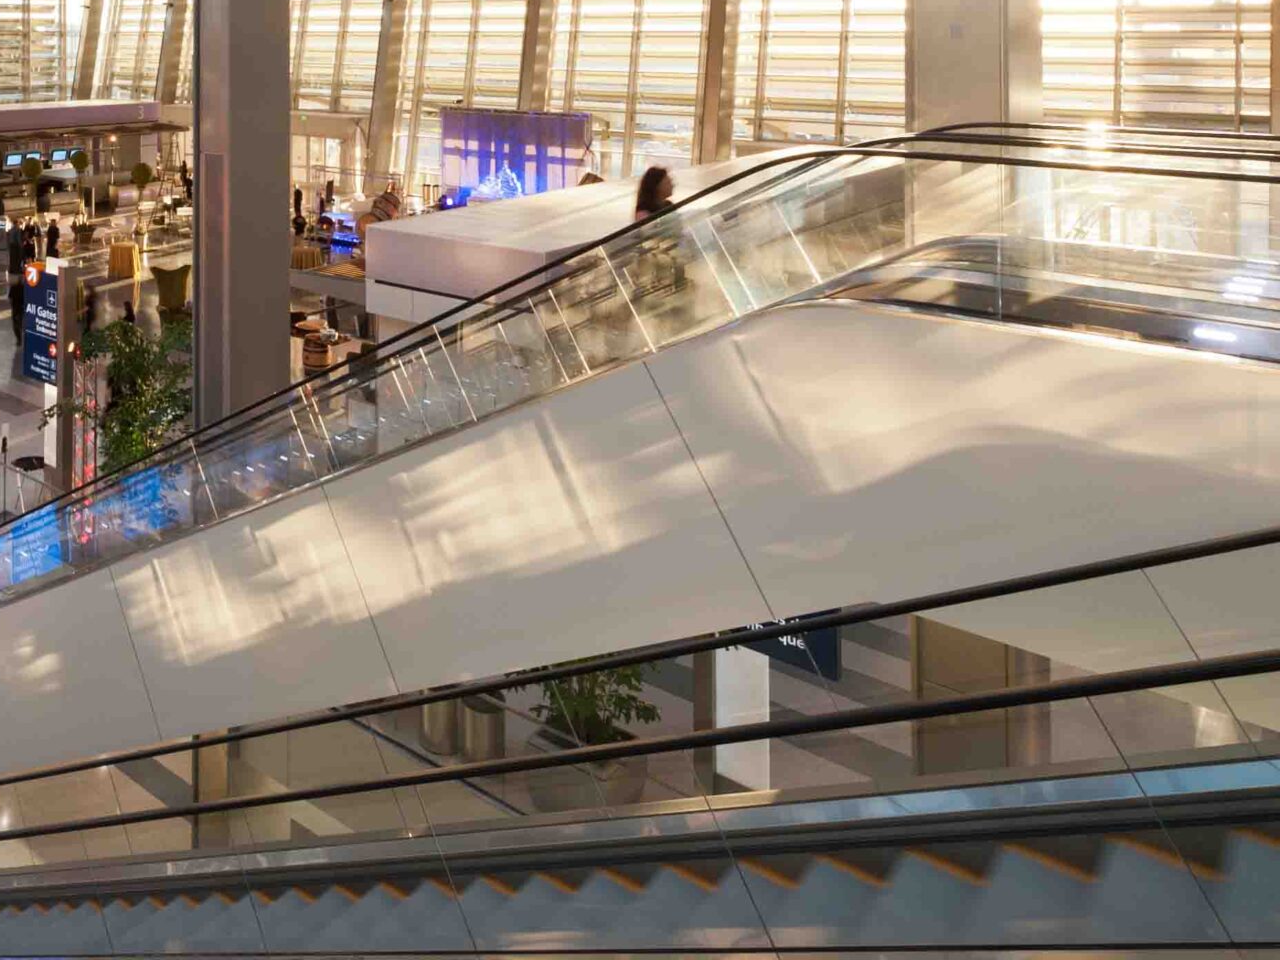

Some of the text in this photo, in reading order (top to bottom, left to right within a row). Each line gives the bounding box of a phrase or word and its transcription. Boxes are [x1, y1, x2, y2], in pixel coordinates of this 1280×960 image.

[137, 105, 144, 119] 3
[26, 303, 57, 321] All Gates
